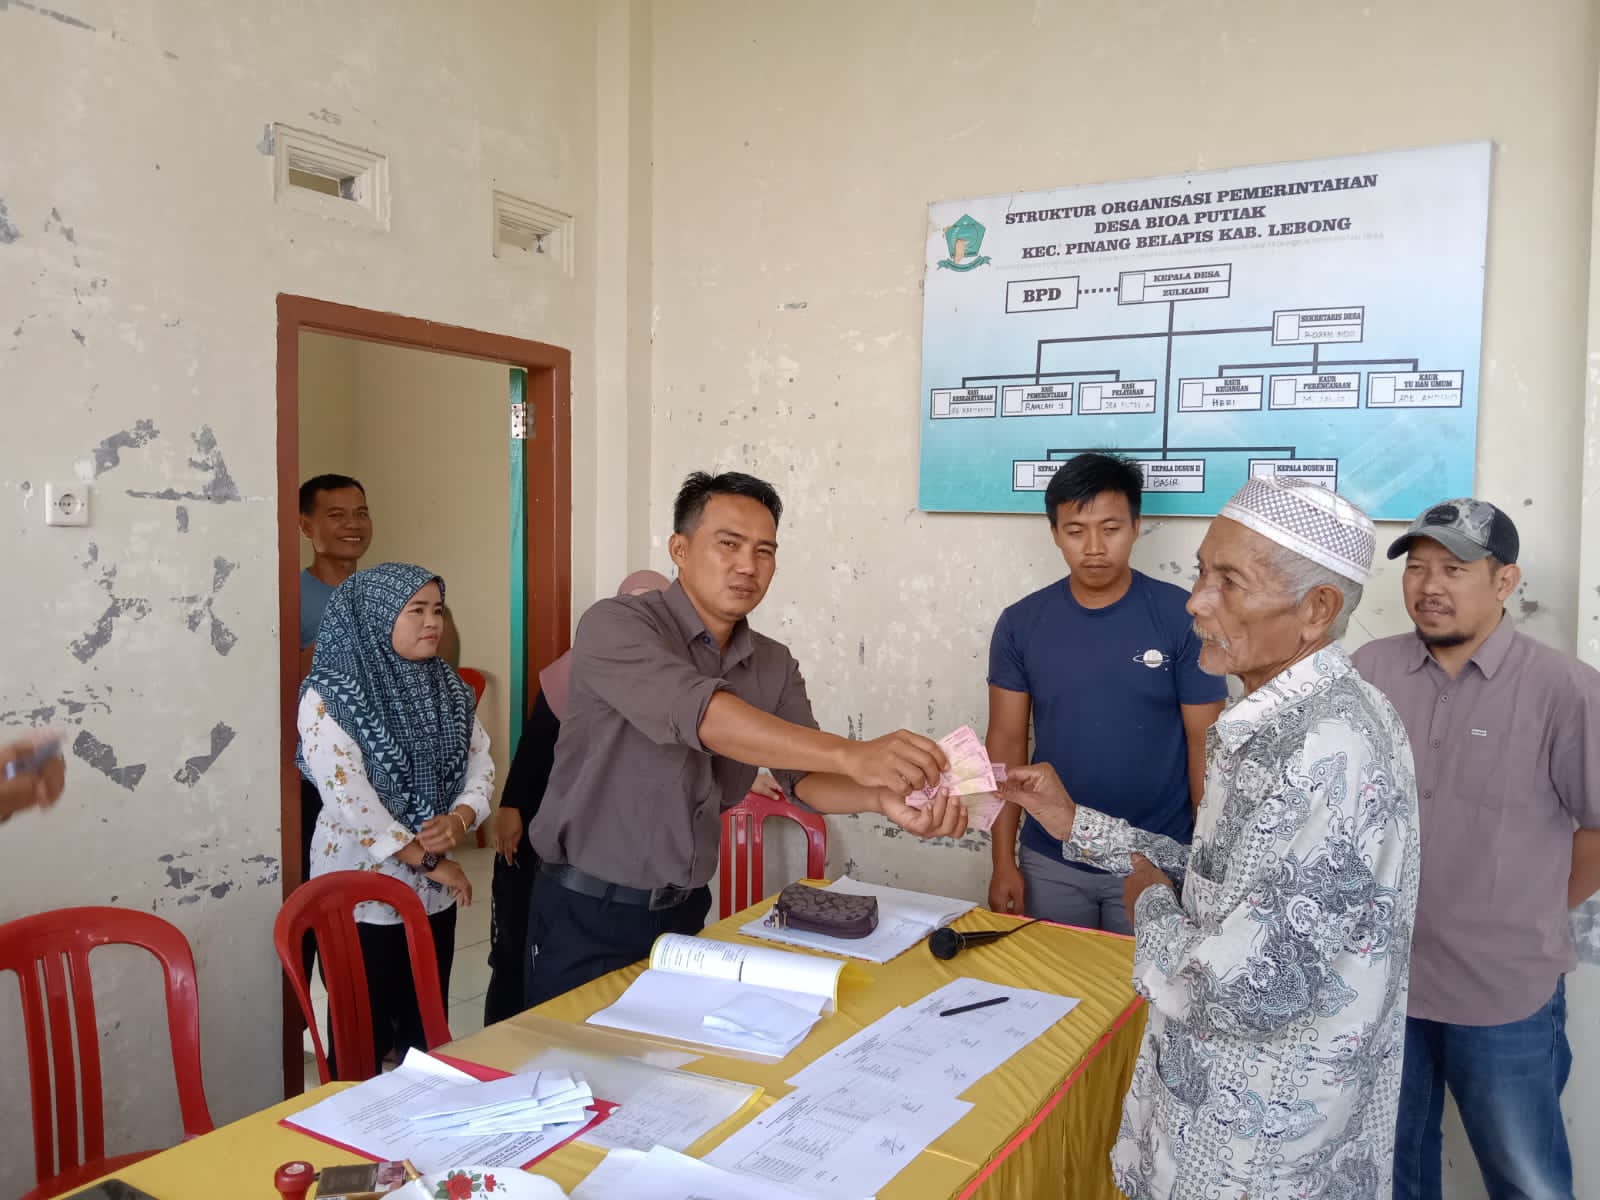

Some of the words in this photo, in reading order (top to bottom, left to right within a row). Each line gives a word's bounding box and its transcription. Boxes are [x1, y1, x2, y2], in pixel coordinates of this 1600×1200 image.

[1005, 204, 1097, 225] STRUKTUR
[1101, 191, 1213, 215] ORGANISASI
[1216, 174, 1379, 203] PEMERINTAHAN
[1094, 217, 1142, 234] DESA
[1145, 213, 1190, 229] BIOA
[1194, 205, 1267, 225] PUTIAK
[1021, 244, 1061, 260] KEC.
[1065, 237, 1131, 255] PINANG
[1135, 229, 1214, 249] BELAPIS
[1219, 226, 1263, 242] KAB.
[1268, 217, 1353, 237] LEBONG
[1153, 271, 1192, 283] KEPALA
[1193, 270, 1221, 280] DESA
[1022, 287, 1062, 304] BPD
[1162, 286, 1210, 297] ZULKAIDI
[1301, 313, 1342, 322] SEKRETARIS
[1343, 312, 1361, 320] DESA
[1276, 464, 1301, 472] KEPALA
[1302, 464, 1325, 472] DUSUN
